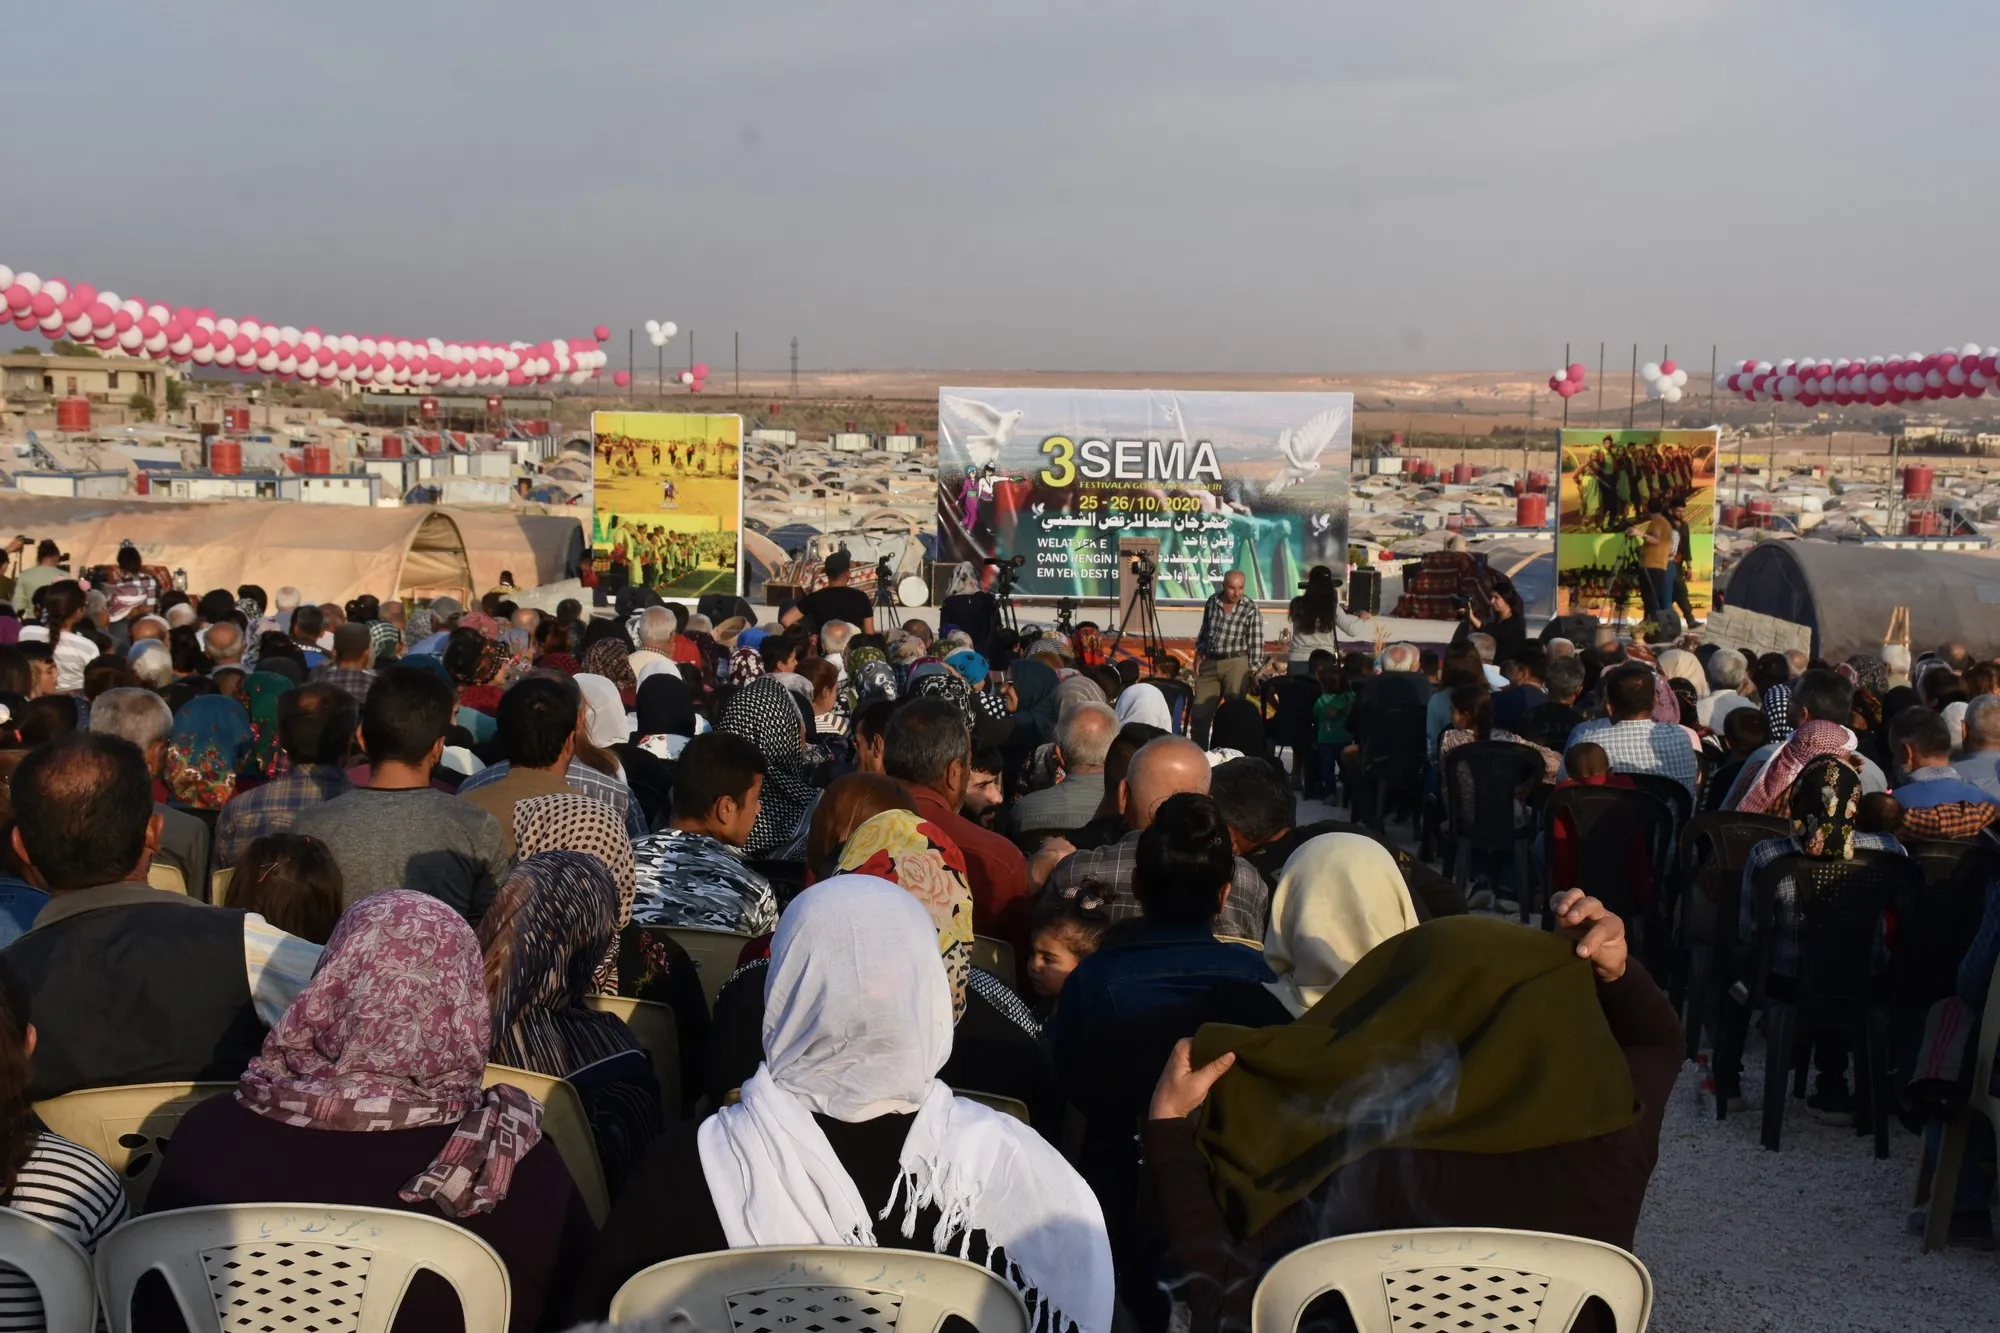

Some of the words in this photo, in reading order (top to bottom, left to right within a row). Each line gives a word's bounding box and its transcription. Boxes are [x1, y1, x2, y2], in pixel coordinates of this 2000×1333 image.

[1041, 436, 1076, 487] 3
[1080, 440, 1222, 480] SEMA
[1079, 481, 1131, 490] FESTIVALA
[1079, 496, 1098, 509] 25
[1110, 496, 1201, 511] 26/10/2020
[1041, 511, 1097, 532] الشعبي
[1146, 512, 1172, 528] سما
[1173, 514, 1230, 532] مهرجان
[1037, 537, 1073, 548] WELAT
[1076, 538, 1097, 549] YEK
[1099, 538, 1108, 548] E
[1183, 534, 1208, 548] واحد
[1210, 531, 1235, 549] وطن
[1036, 552, 1068, 565] ÇAND
[1070, 551, 1112, 564] RENGÎN
[1036, 567, 1055, 578] EM
[1056, 568, 1078, 578] YEK
[1080, 568, 1109, 579] DEST
